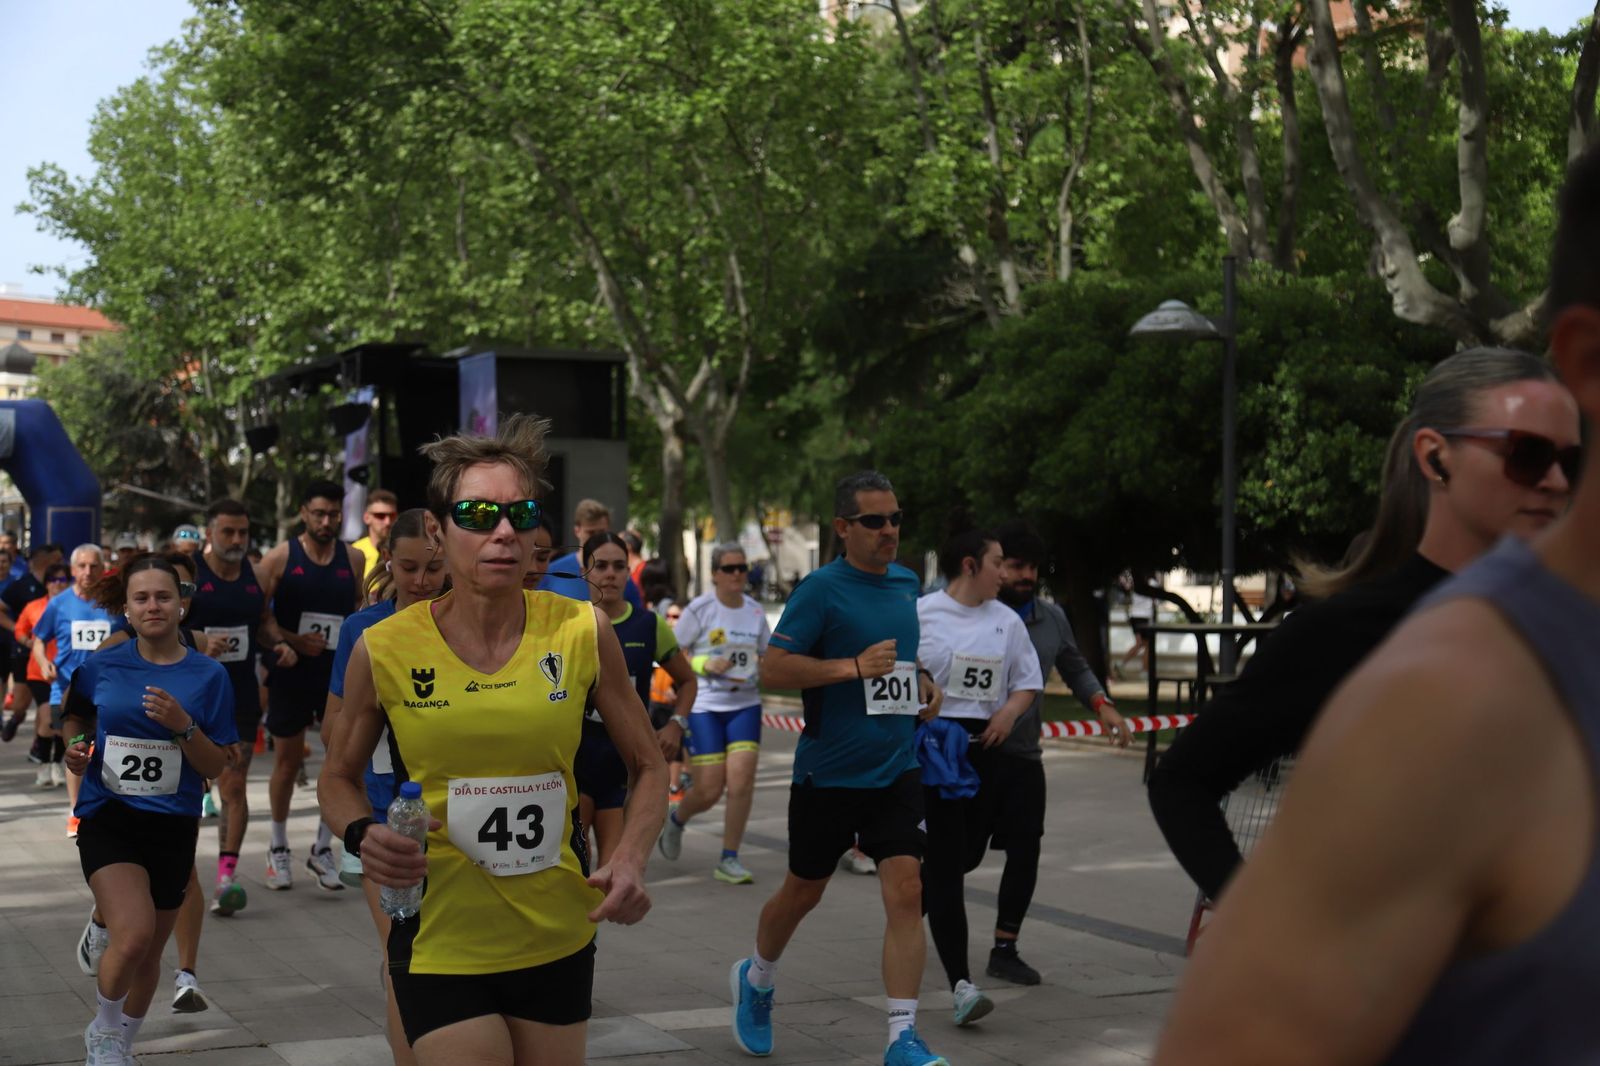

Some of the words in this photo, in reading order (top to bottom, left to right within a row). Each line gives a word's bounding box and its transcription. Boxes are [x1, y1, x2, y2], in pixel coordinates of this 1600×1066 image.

[77, 630, 106, 642] 137
[494, 681, 517, 689] SPORT
[963, 667, 993, 689] 53
[549, 690, 567, 701] GCB
[871, 677, 912, 701] 201
[120, 754, 163, 782] 28
[455, 785, 472, 796] DÍA
[474, 787, 487, 795] DE
[490, 785, 534, 795] CASTILLA
[542, 779, 562, 791] LEÓN
[478, 804, 544, 851] 43
